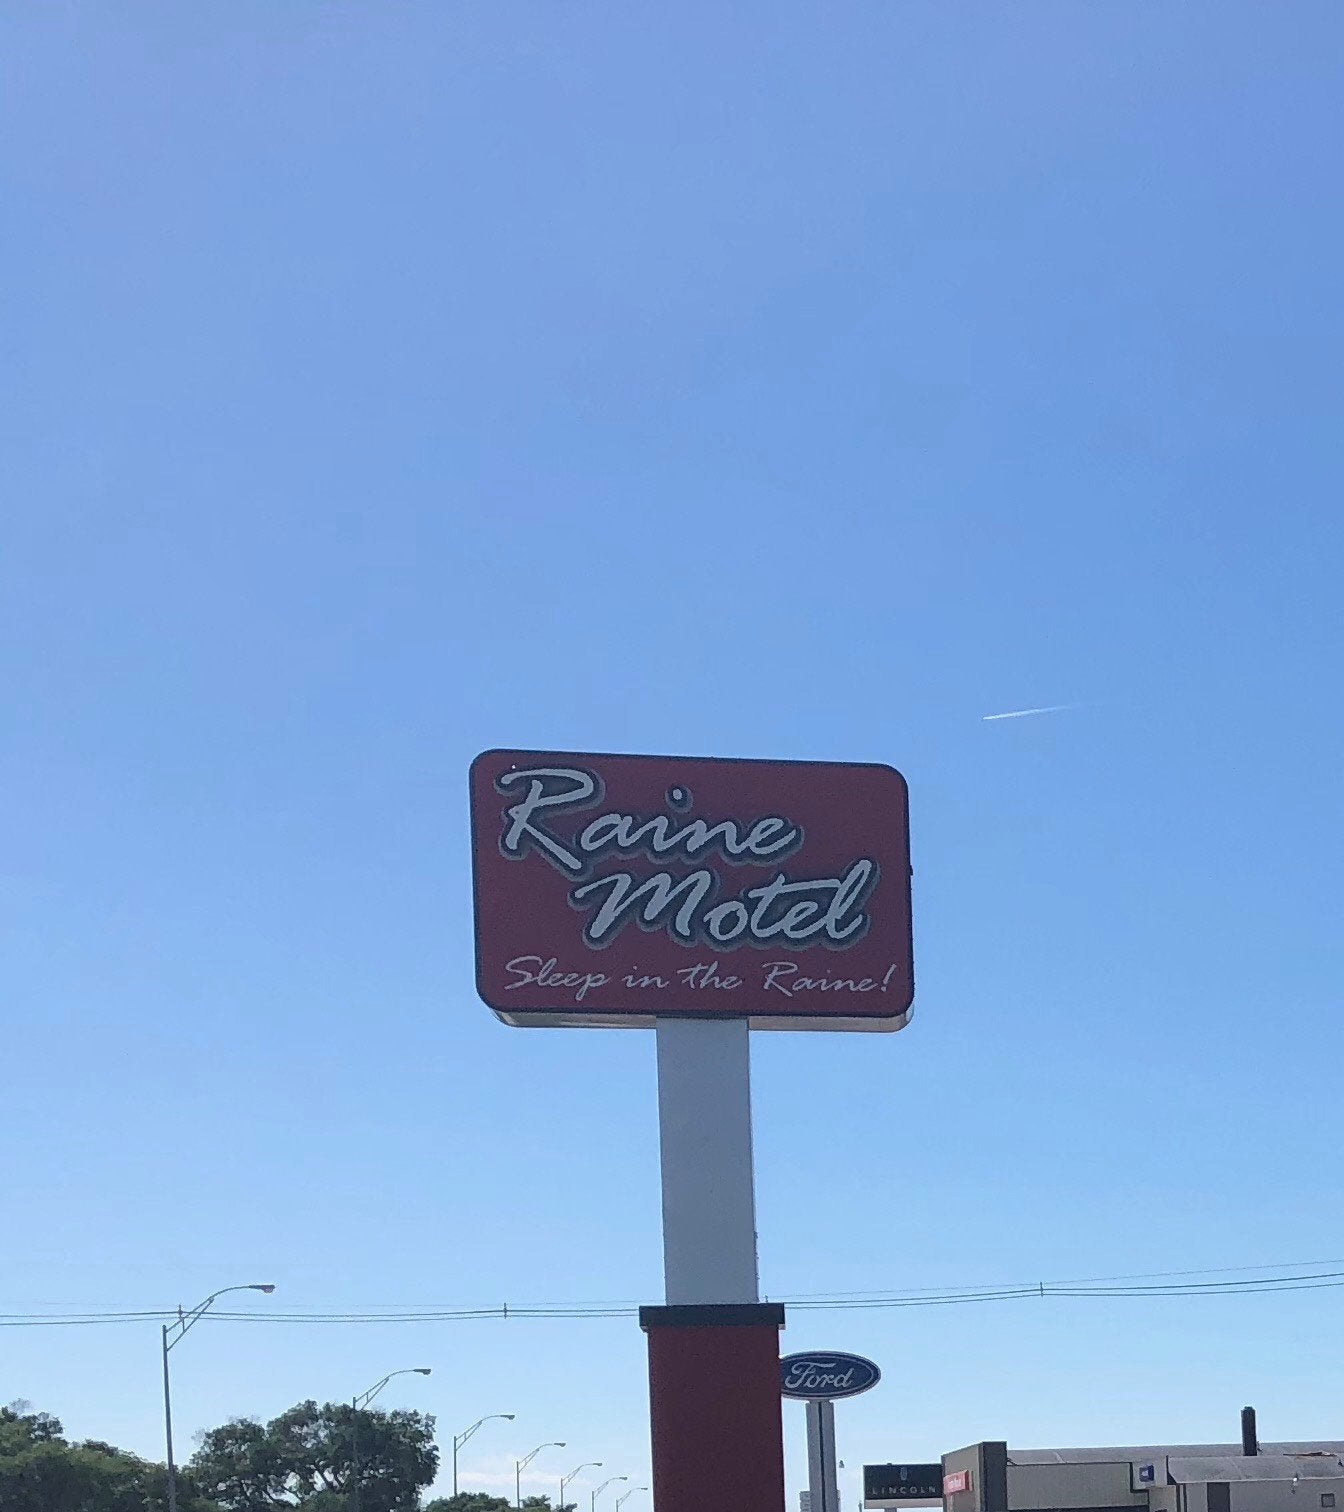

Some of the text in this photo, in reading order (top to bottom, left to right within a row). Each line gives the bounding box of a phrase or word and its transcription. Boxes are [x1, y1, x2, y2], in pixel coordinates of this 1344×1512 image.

[497, 767, 800, 874] Raine
[570, 858, 874, 944] Motel
[503, 955, 898, 1001] Sleep in the Raine!
[784, 1361, 855, 1389] Ford
[871, 1486, 936, 1495] LINCOLN
